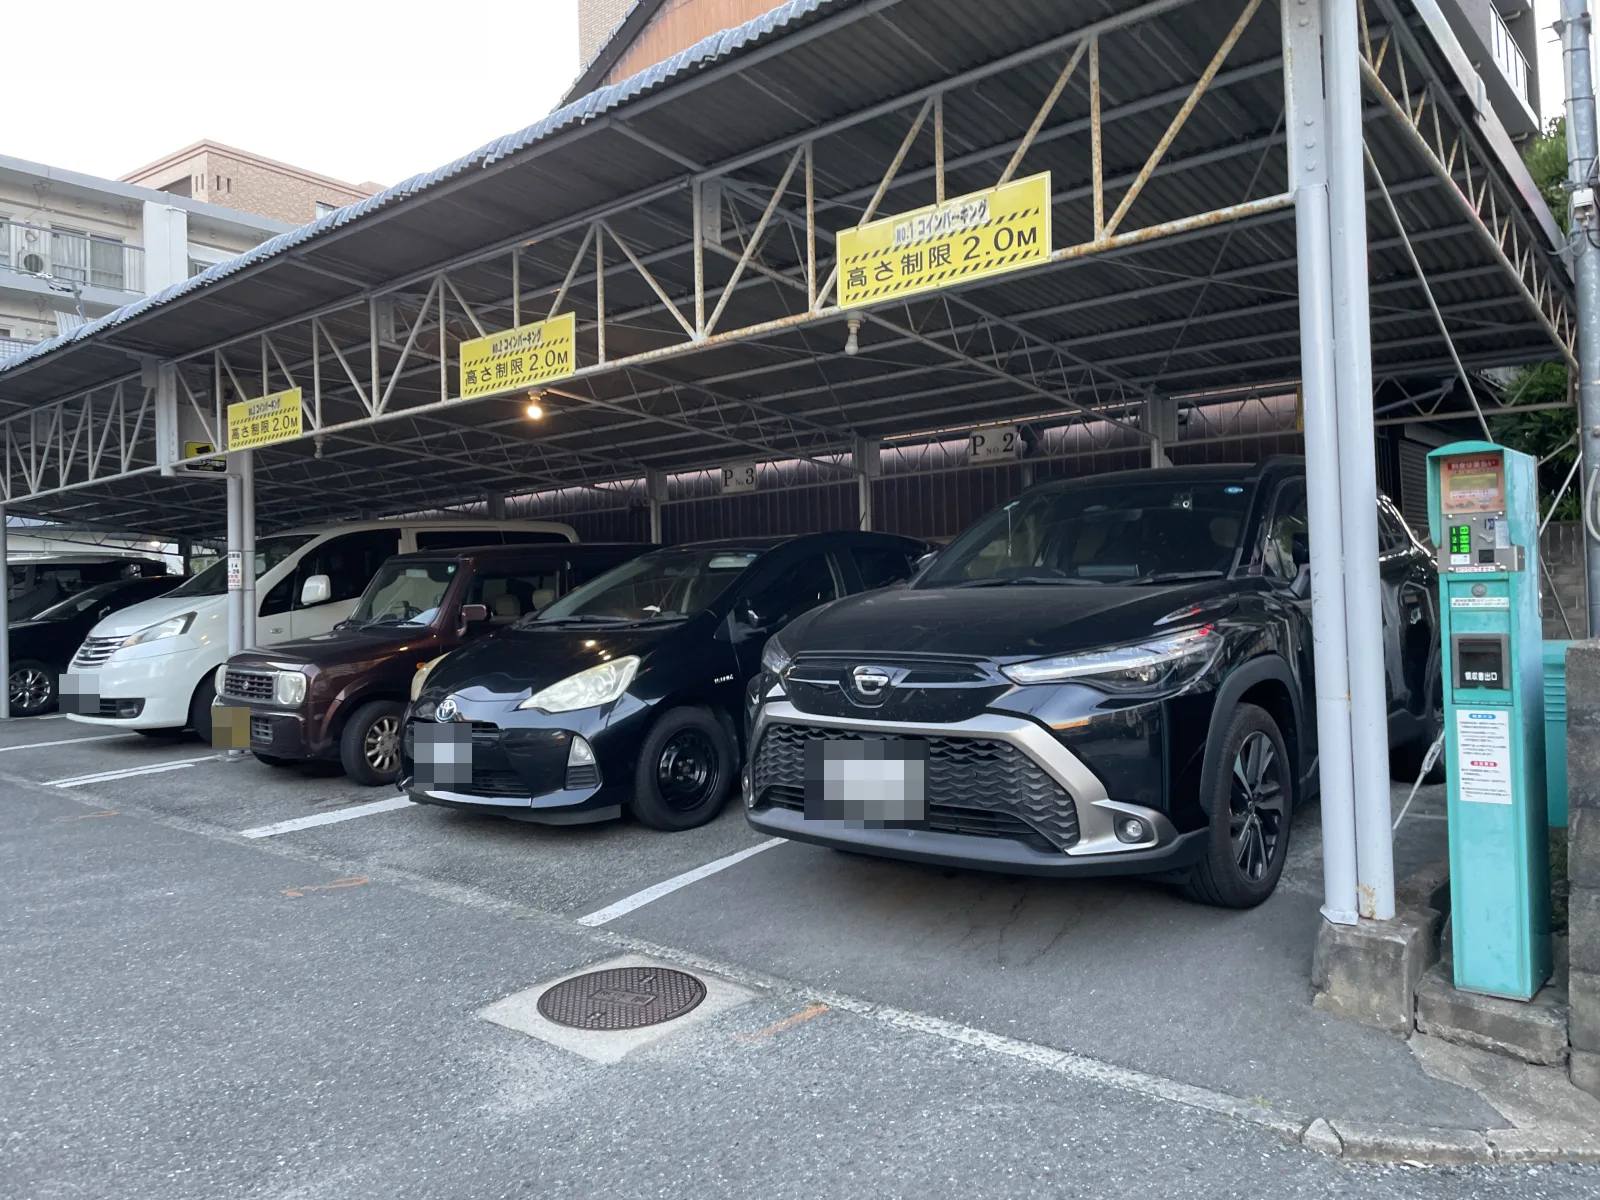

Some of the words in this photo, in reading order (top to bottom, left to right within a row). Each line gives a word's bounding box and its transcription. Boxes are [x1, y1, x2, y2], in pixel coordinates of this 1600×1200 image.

[917, 198, 988, 236] コインパーキング
[846, 243, 952, 290] 高さ制限
[465, 357, 524, 387] 高さ制限
[231, 420, 270, 441] 高さ制限
[971, 434, 985, 456] P
[1002, 432, 1014, 453] 2
[723, 469, 733, 487] P
[745, 467, 754, 485] 3
